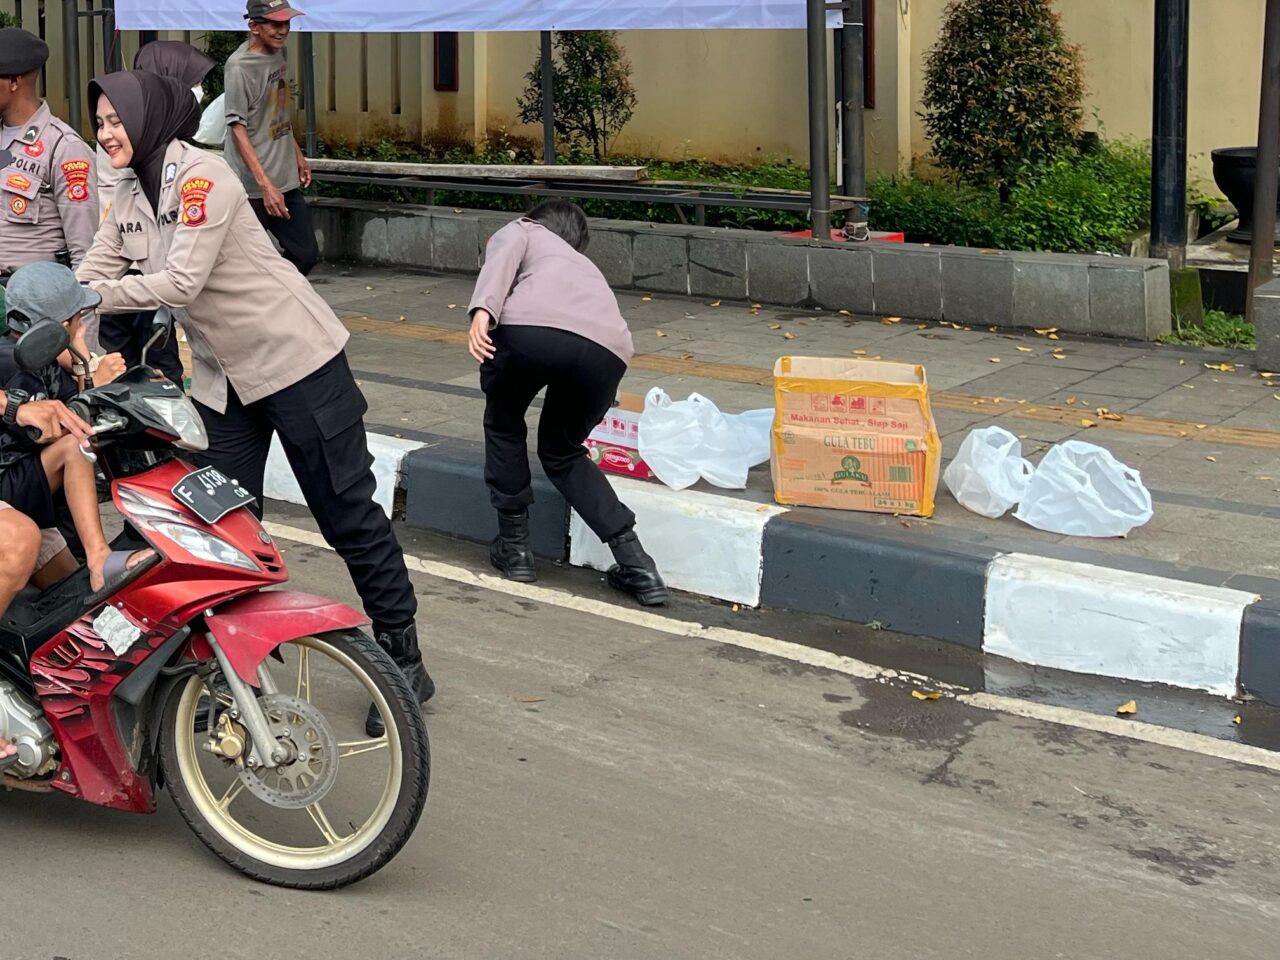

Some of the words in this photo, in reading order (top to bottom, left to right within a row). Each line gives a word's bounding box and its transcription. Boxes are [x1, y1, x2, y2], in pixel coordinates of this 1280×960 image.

[9, 156, 40, 175] POLRI
[790, 413, 831, 424] Makanan
[833, 416, 859, 426] Sehat
[867, 418, 888, 429] Siap
[890, 420, 908, 431] Saji
[824, 435, 849, 449] GULA
[852, 437, 876, 450] TEBU
[835, 471, 868, 481] GULAKU
[178, 486, 195, 504] F
